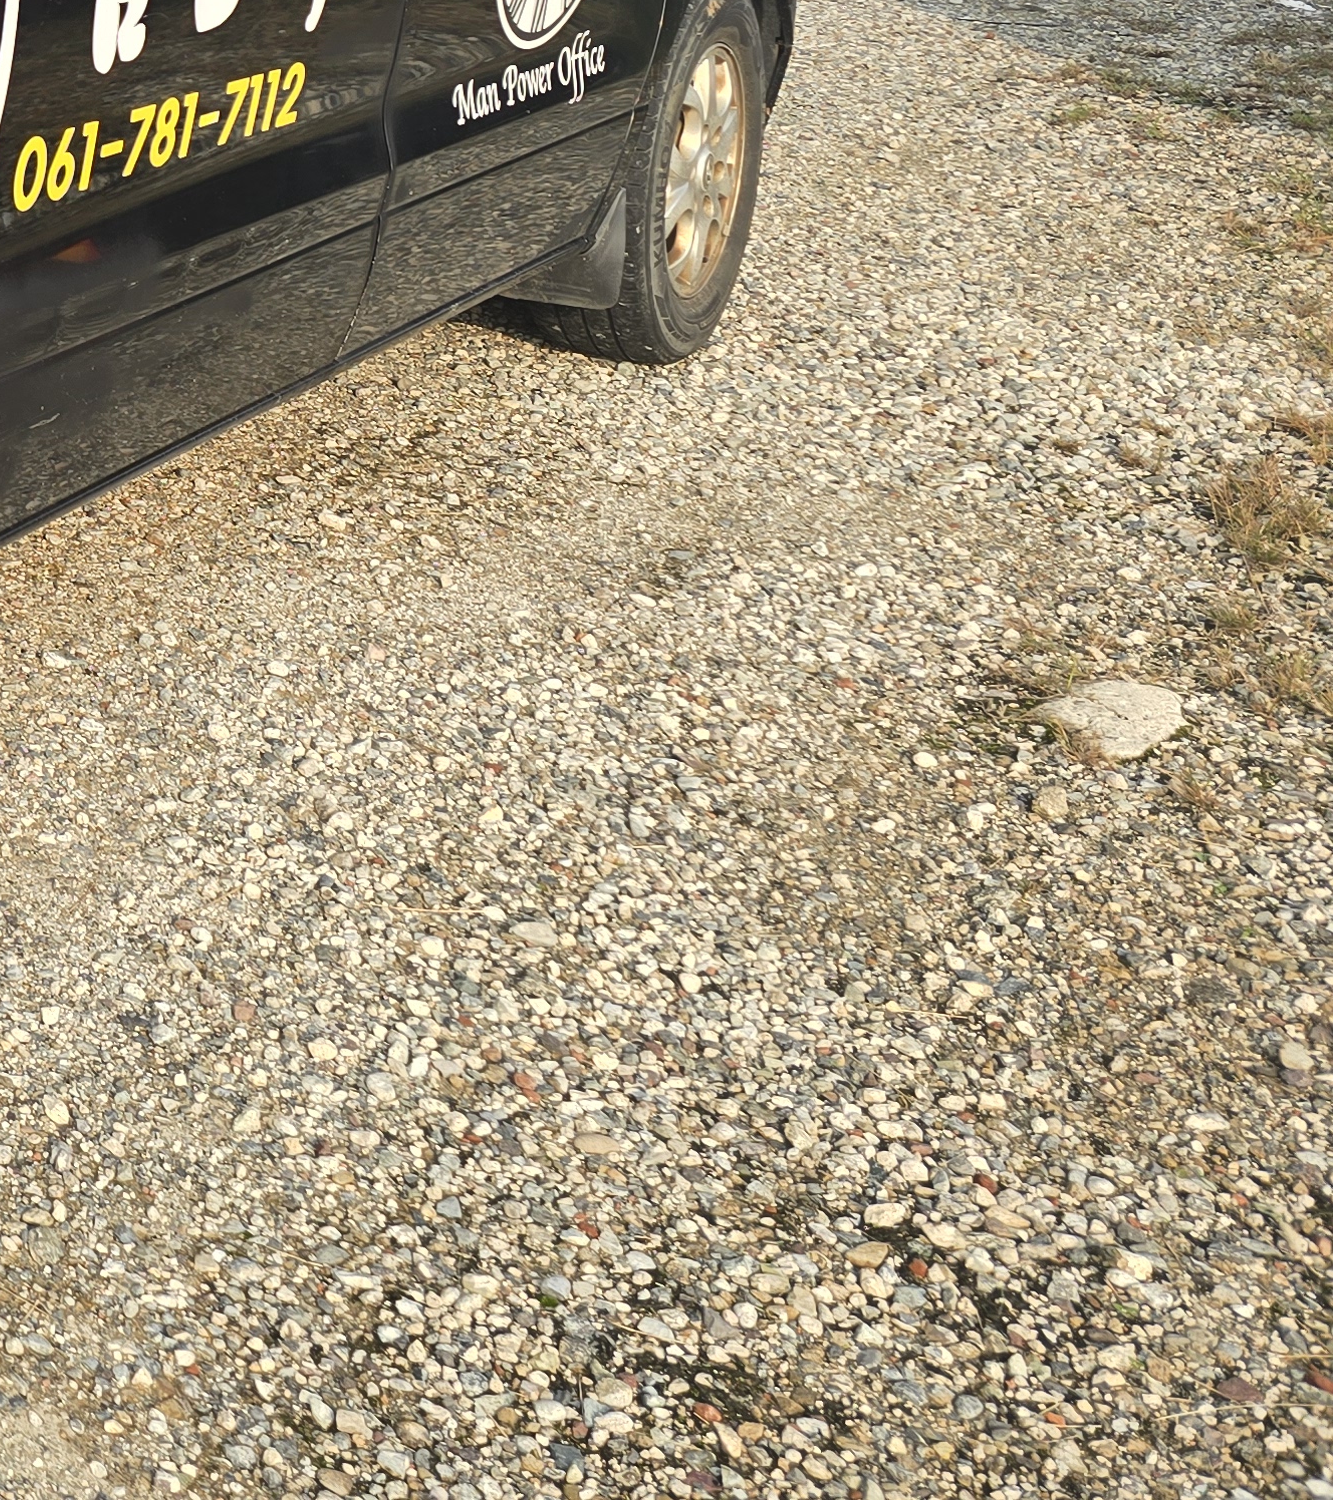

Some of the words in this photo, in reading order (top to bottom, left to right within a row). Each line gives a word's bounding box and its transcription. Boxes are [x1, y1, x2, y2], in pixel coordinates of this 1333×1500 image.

[13, 62, 306, 212] 061-781-7112
[452, 79, 501, 125] Man
[502, 64, 555, 106] Power
[557, 30, 606, 104] Office
[652, 145, 670, 268] KUMHO
